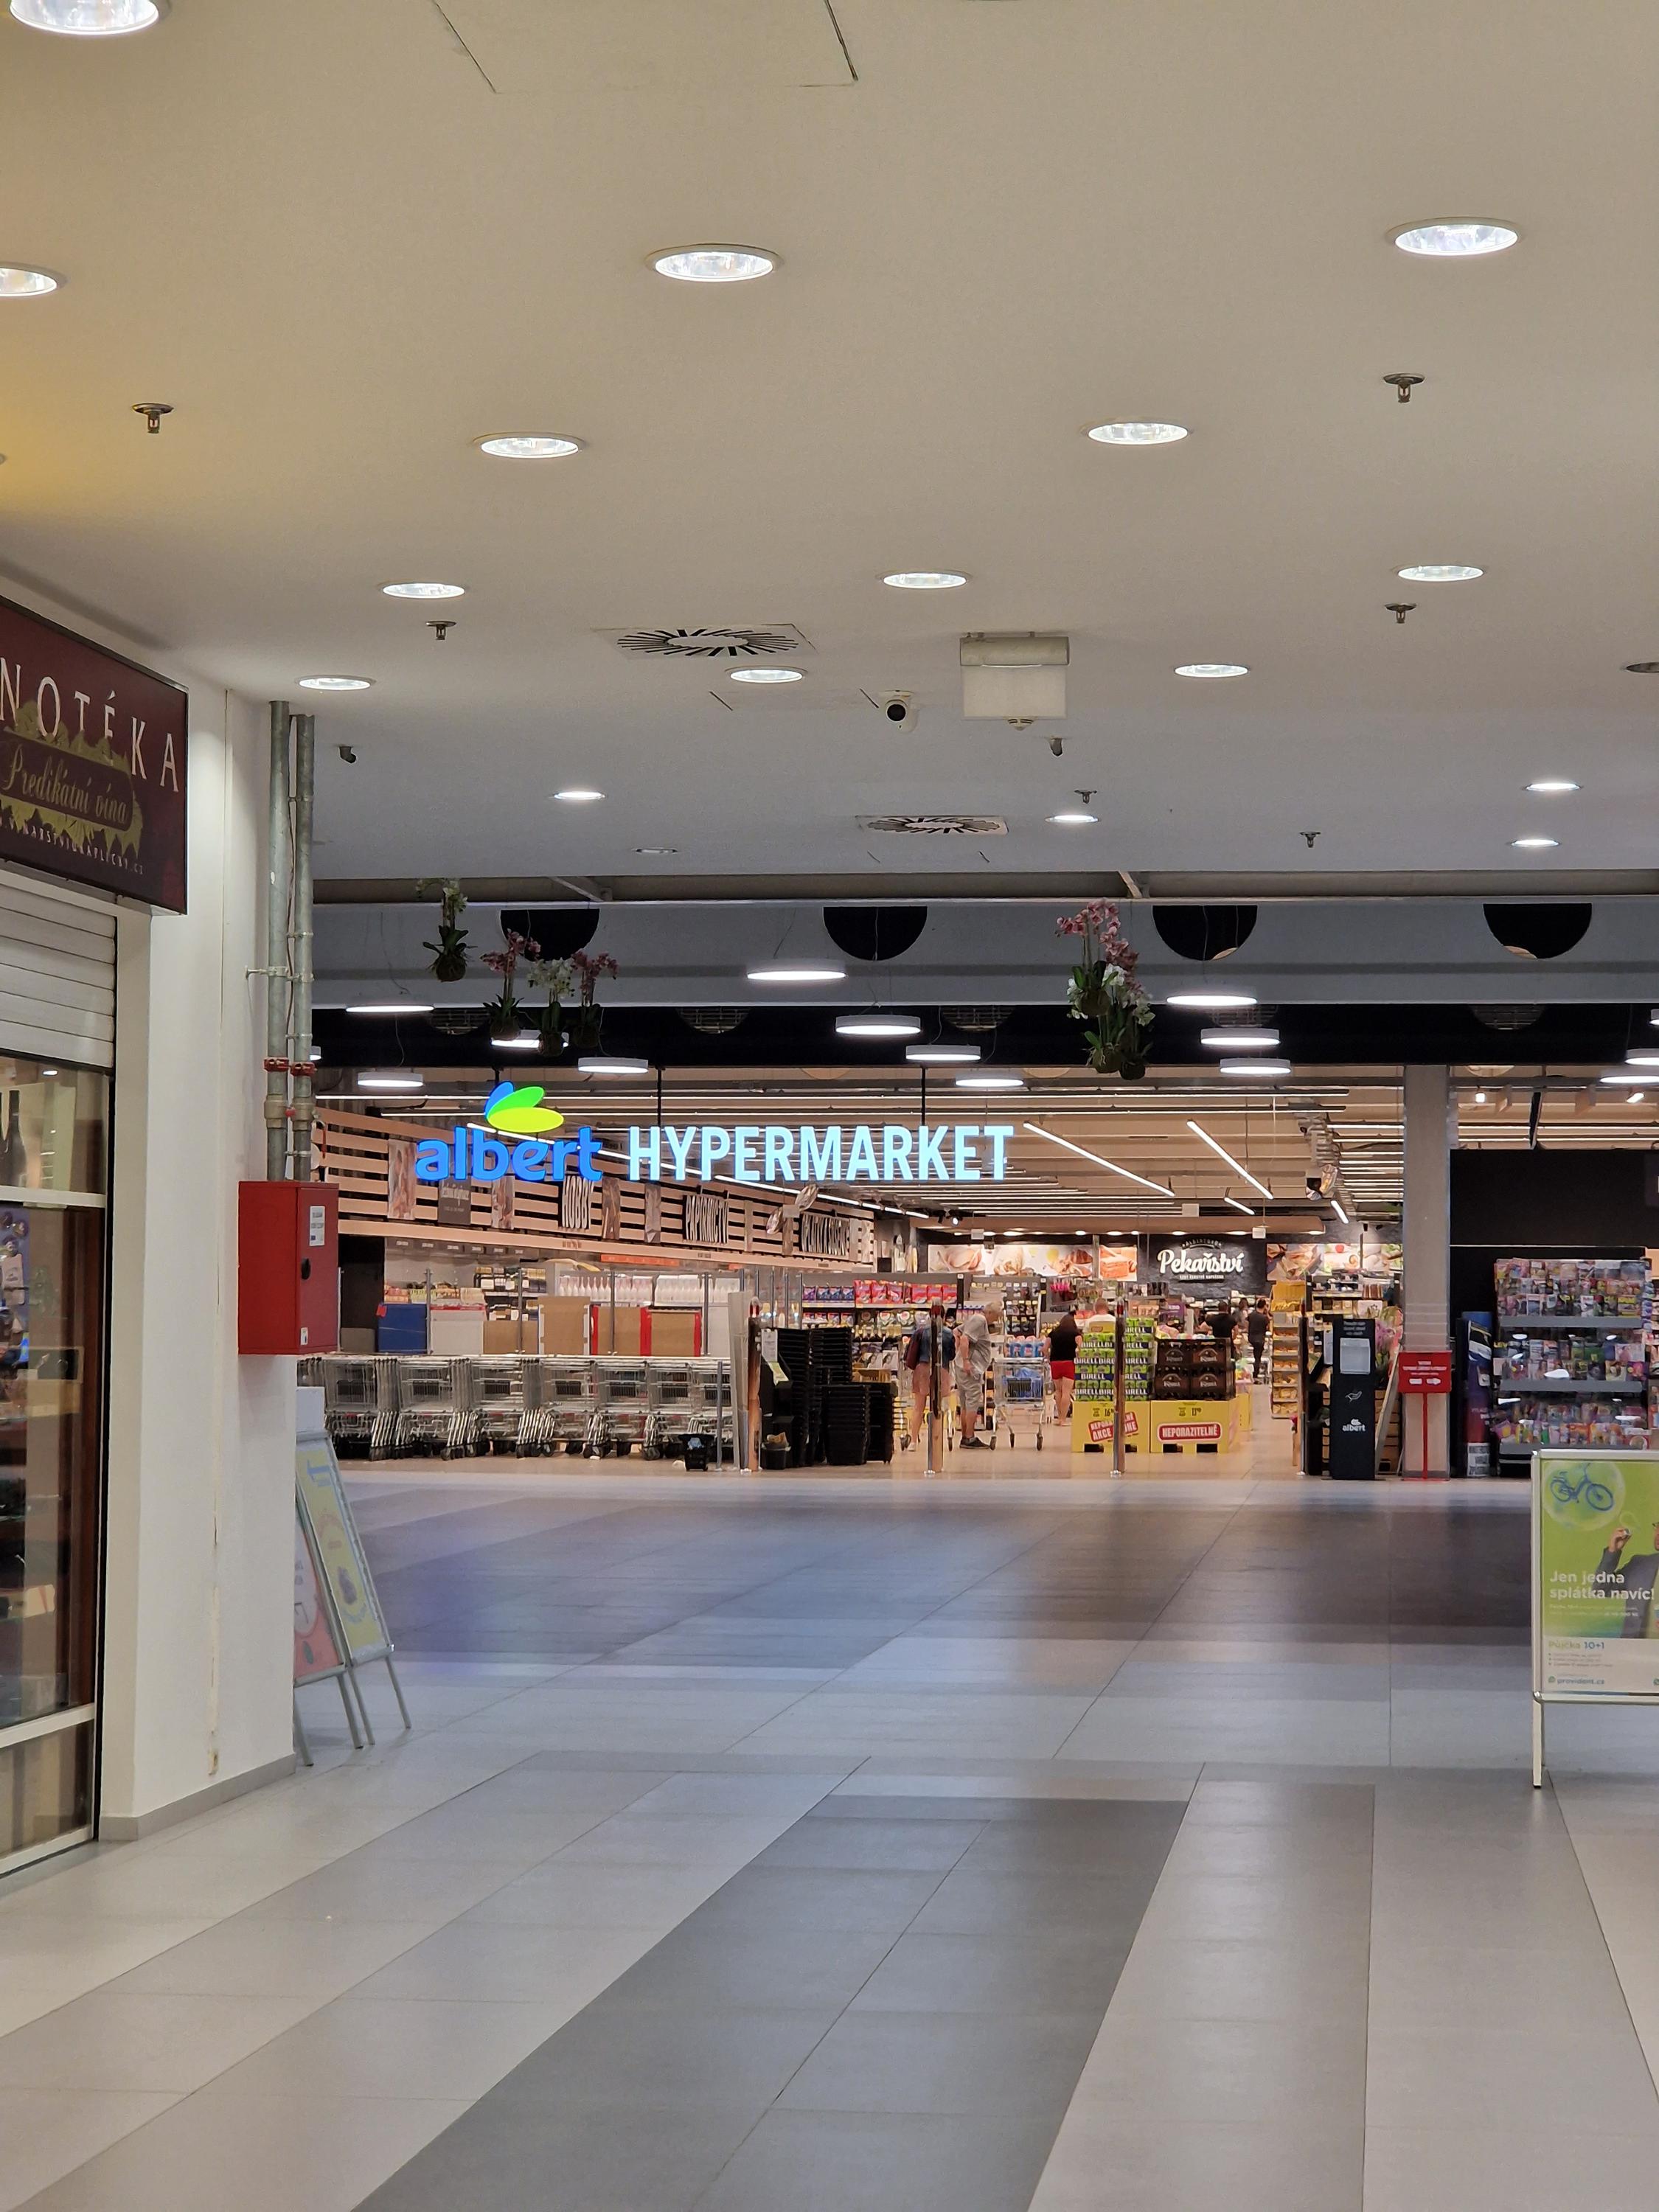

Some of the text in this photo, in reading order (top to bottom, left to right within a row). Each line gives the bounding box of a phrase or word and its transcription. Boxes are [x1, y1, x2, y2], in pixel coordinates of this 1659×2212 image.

[415, 1126, 1014, 1181] albert HYPERMARKET
[1157, 1250, 1245, 1274] Pekařství
[1092, 1427, 1112, 1441] AKCE
[1162, 1425, 1218, 1437] NEPORAZITELNÉ
[1342, 1424, 1366, 1432] albert
[1550, 1570, 1625, 1584] Jen jedna
[1550, 1586, 1606, 1601] splátka
